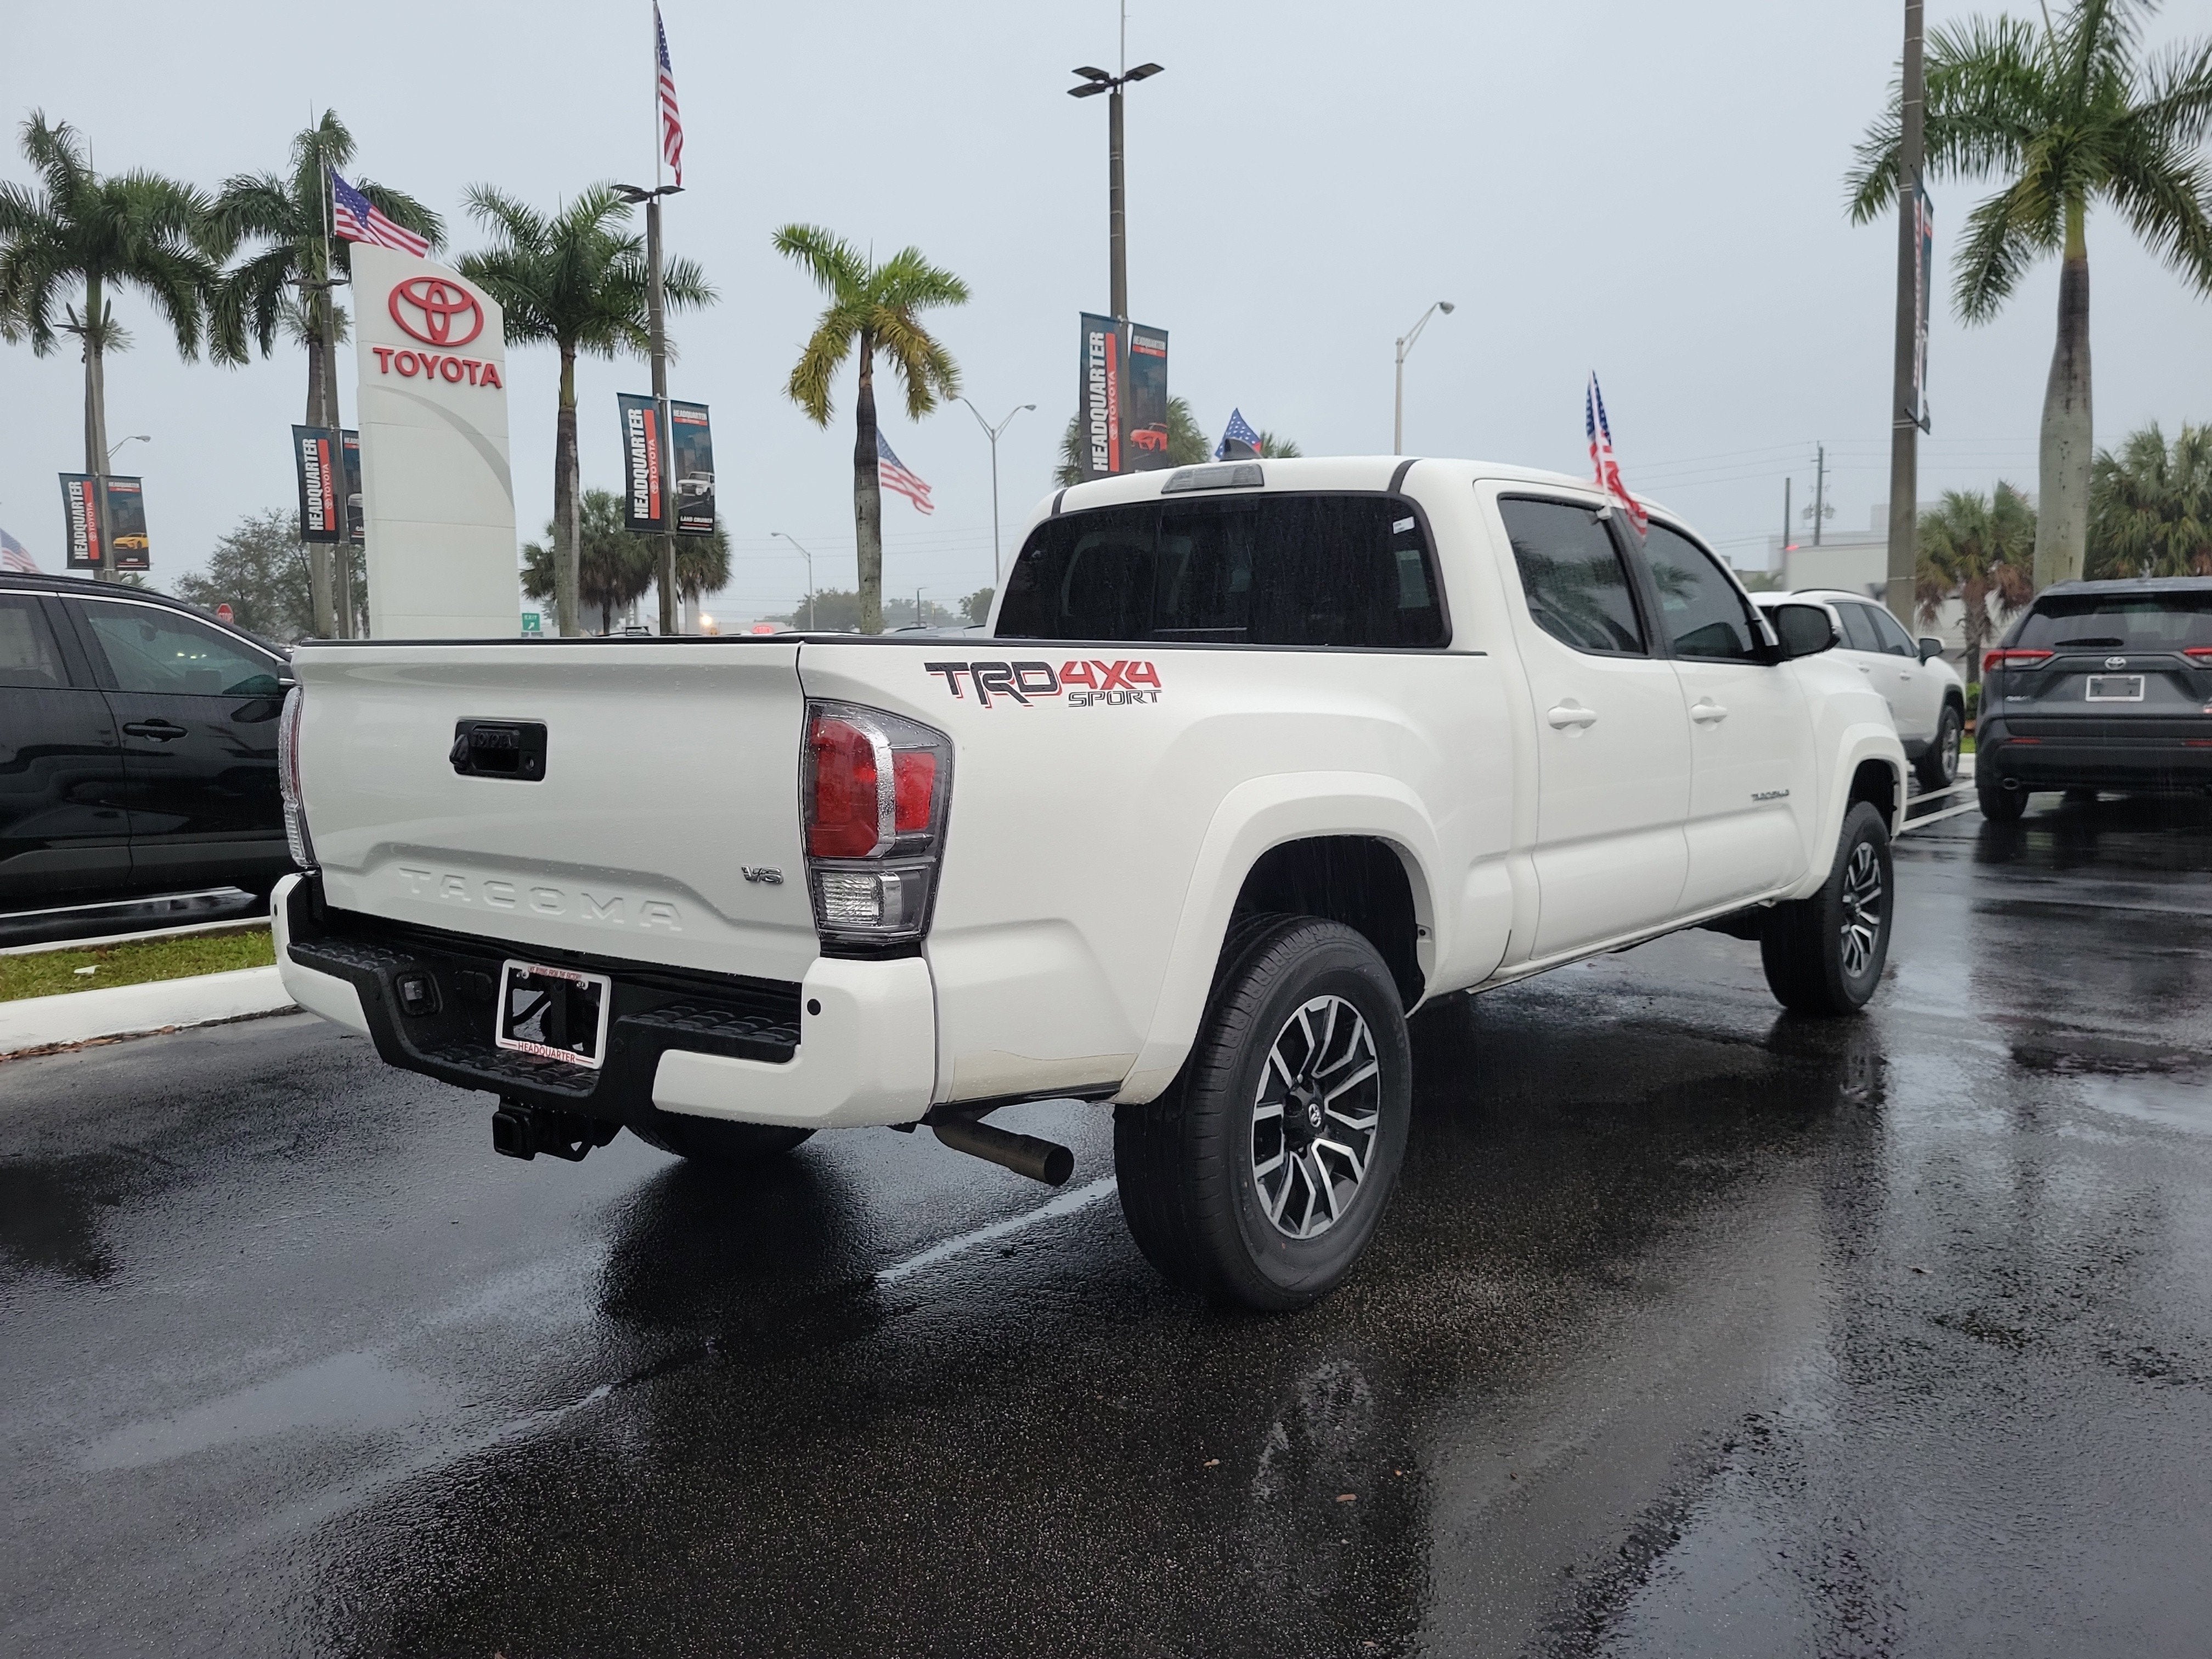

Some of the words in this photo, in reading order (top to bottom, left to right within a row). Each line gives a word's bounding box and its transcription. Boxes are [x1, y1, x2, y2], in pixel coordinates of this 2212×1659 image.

[373, 347, 503, 389] TOYOTA
[1089, 331, 1109, 472] HEADQUARTER
[1108, 371, 1118, 422] TOYOTA
[323, 463, 334, 501] TOYOTA
[628, 409, 649, 519] HEADQUARTER
[647, 439, 658, 481] TOYOTA
[302, 438, 324, 531] HEADQUARTER
[68, 481, 89, 560] HEADQUARTER
[87, 501, 97, 534] TOYOTA
[924, 661, 1063, 709] TRD
[1068, 689, 1162, 708] SPORT
[741, 866, 784, 884] V6
[398, 867, 682, 932] TACOMA
[517, 1041, 575, 1063] HEADQUARTER
